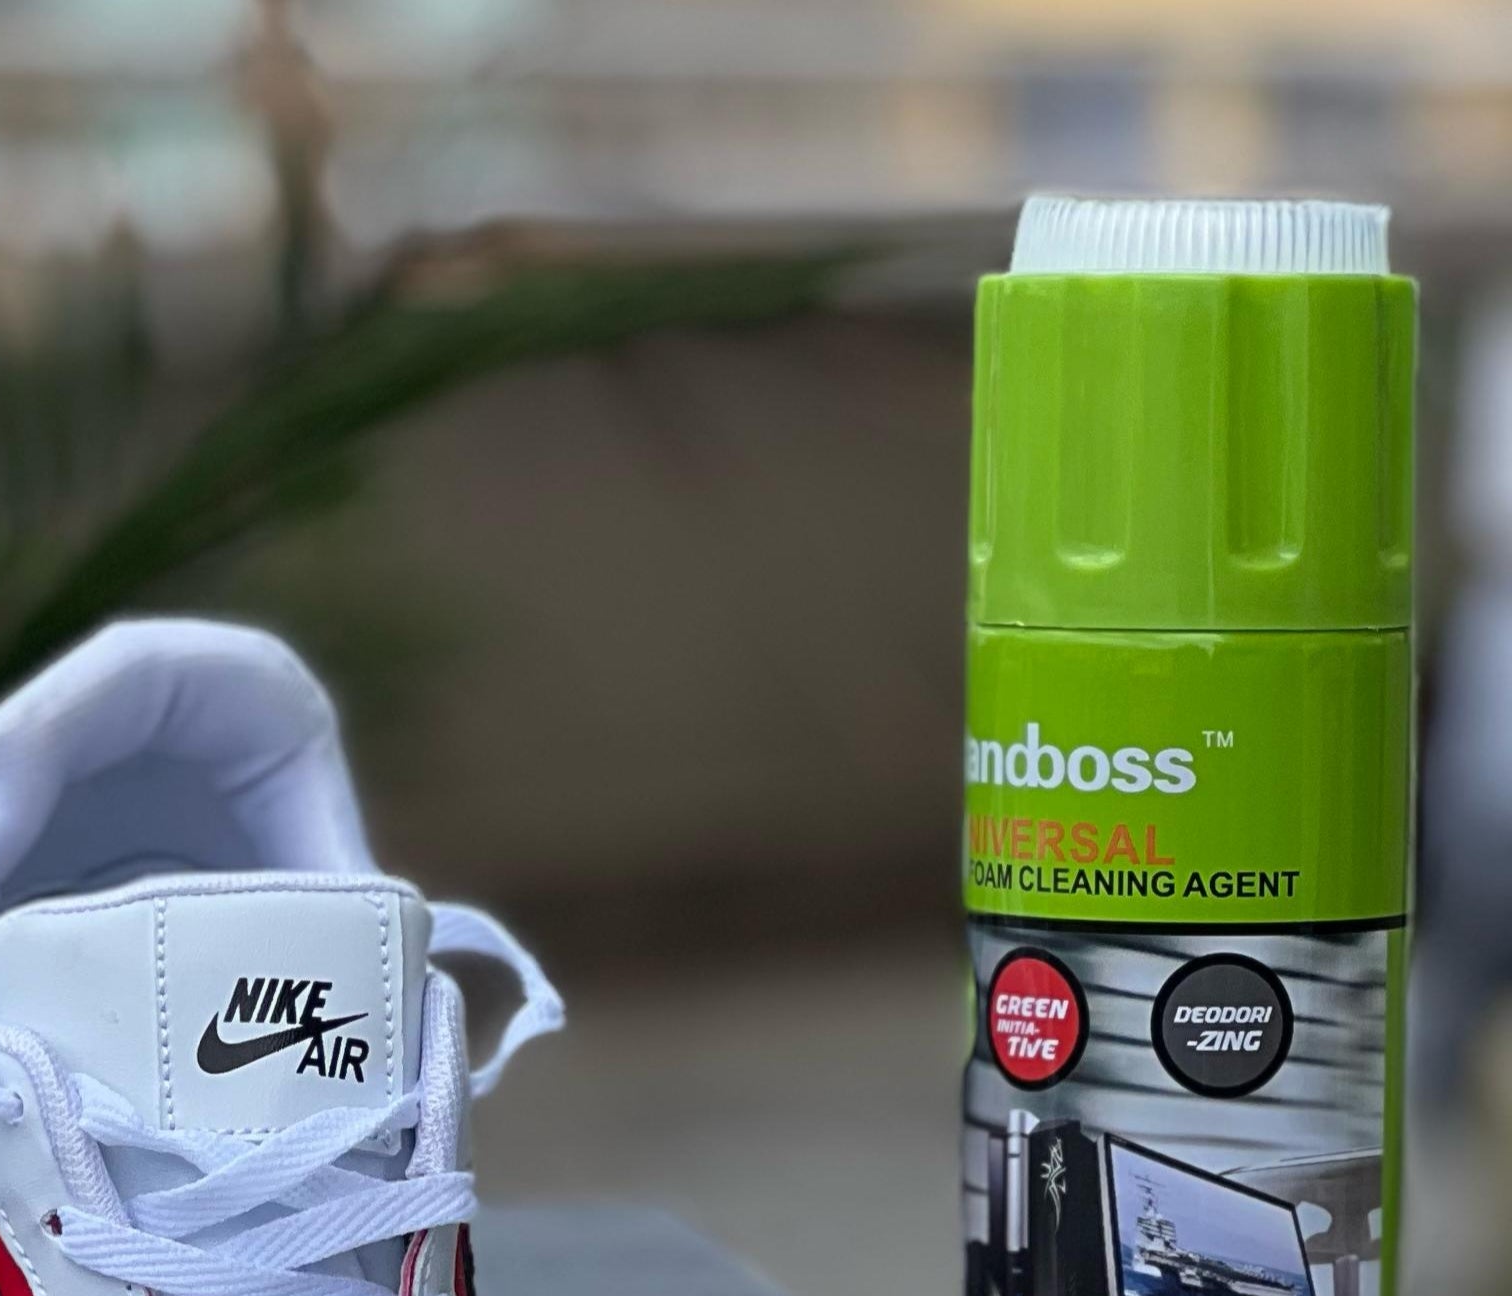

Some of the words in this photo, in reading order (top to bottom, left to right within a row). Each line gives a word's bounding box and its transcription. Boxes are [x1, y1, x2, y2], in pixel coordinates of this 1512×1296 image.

[1202, 730, 1234, 748] TM
[1019, 864, 1176, 898] CLEANING
[1182, 870, 1300, 898] AGENT
[223, 977, 333, 1025] NIKE
[995, 994, 1069, 1020] GREEN
[996, 1018, 1041, 1036] INITIA-
[1174, 1005, 1272, 1025] DEODORI
[1007, 1036, 1059, 1061] TIVE
[1187, 1030, 1263, 1052] -ZING
[296, 1032, 370, 1083] AIR
